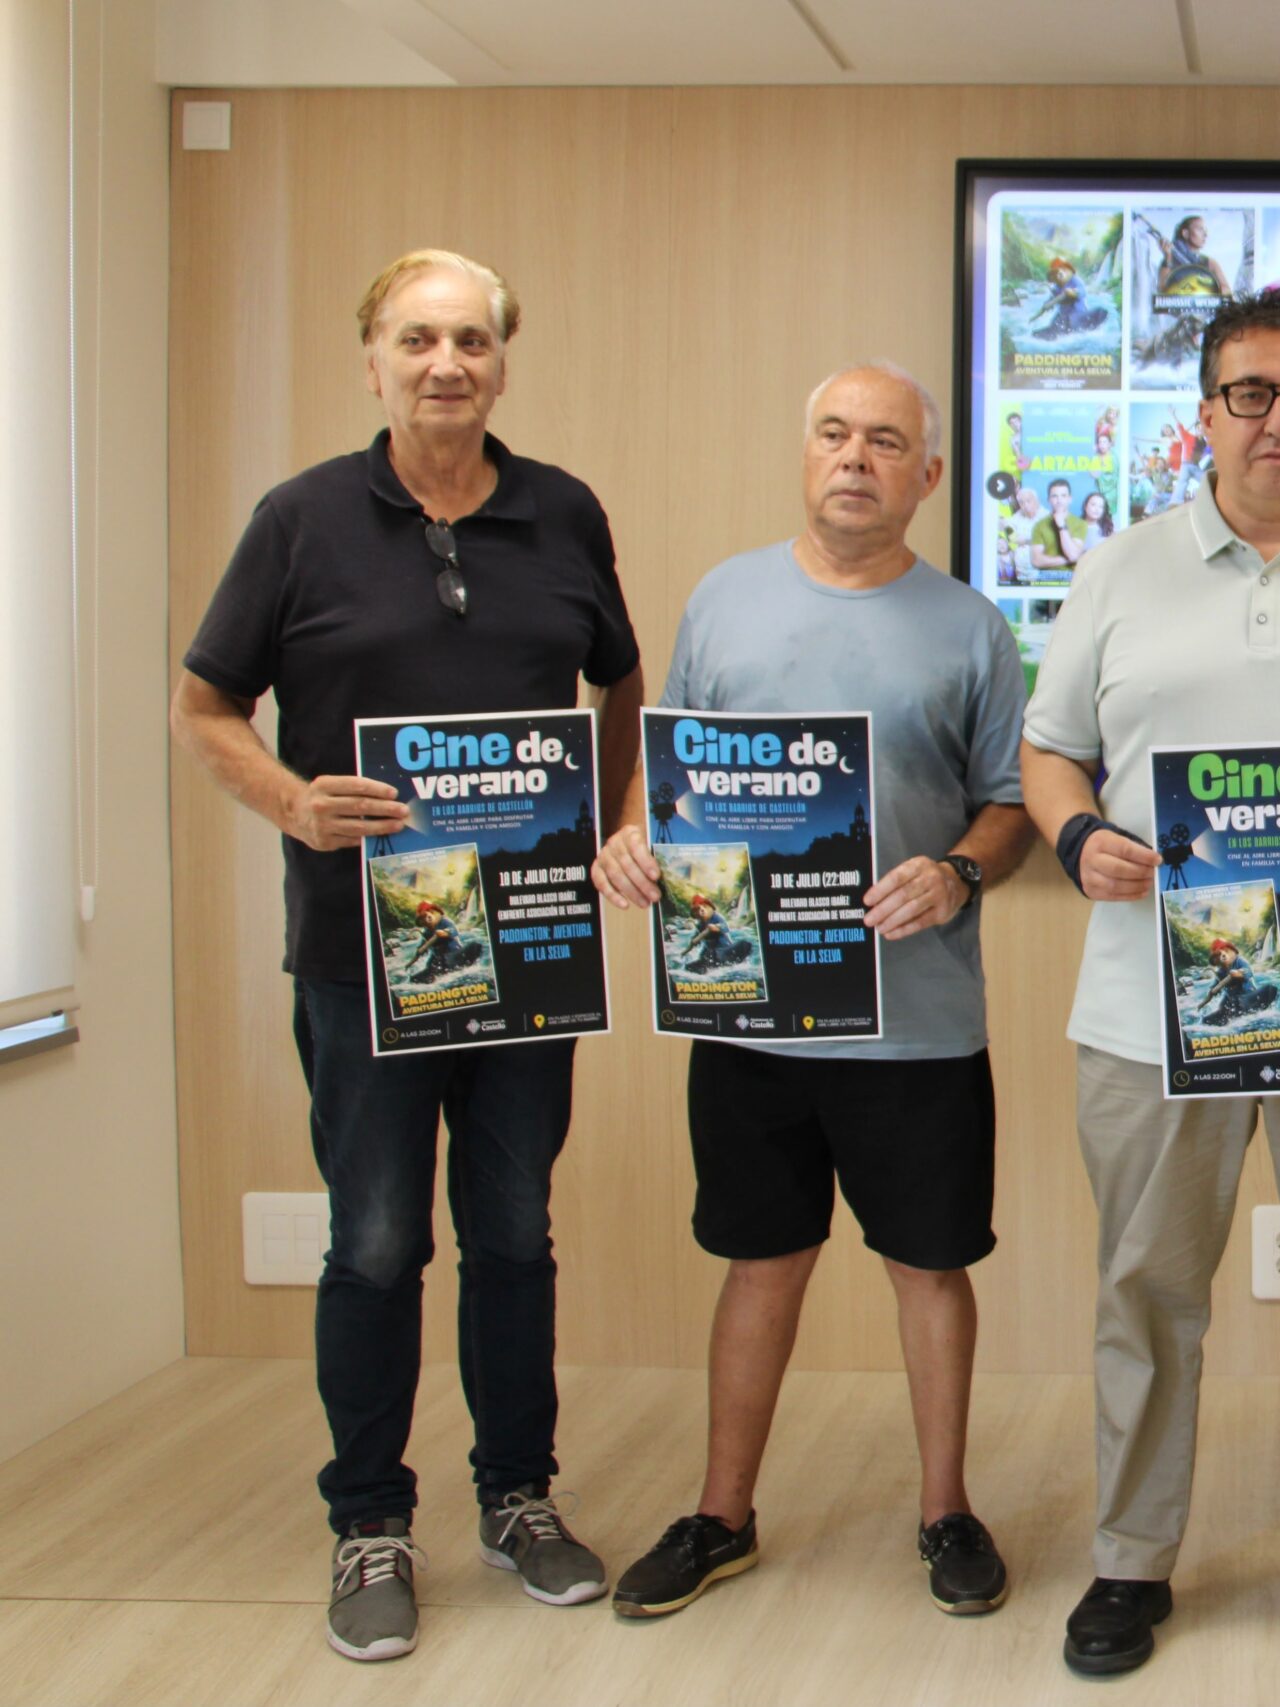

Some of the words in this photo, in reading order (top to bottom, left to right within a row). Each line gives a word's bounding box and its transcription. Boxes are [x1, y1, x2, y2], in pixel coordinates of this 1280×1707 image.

[1014, 353, 1112, 366] PADDINGTON
[395, 725, 511, 771] Cine
[516, 731, 564, 764] de
[673, 719, 782, 767] Cine
[788, 733, 838, 766] de
[412, 768, 547, 800] verano
[687, 769, 821, 796] verano
[512, 871, 522, 885] DE
[525, 869, 547, 884] JULIO
[550, 865, 586, 883] (22:00H)
[783, 873, 794, 888] DE
[796, 873, 820, 888] JULIO
[822, 869, 860, 888] (22:00H)
[499, 926, 551, 943] PADDINGTON:
[553, 923, 592, 939] AVENTURA
[769, 930, 822, 944] PADDINGTON:
[824, 928, 865, 943] AVENTURA
[524, 947, 534, 961] EN
[536, 946, 546, 960] LA
[548, 944, 571, 960] SELVA
[794, 950, 804, 964] EN
[807, 949, 816, 963] LA
[818, 948, 842, 963] SELVA
[400, 983, 488, 1008] PADDINGTON
[676, 982, 757, 993] PADDINGTON
